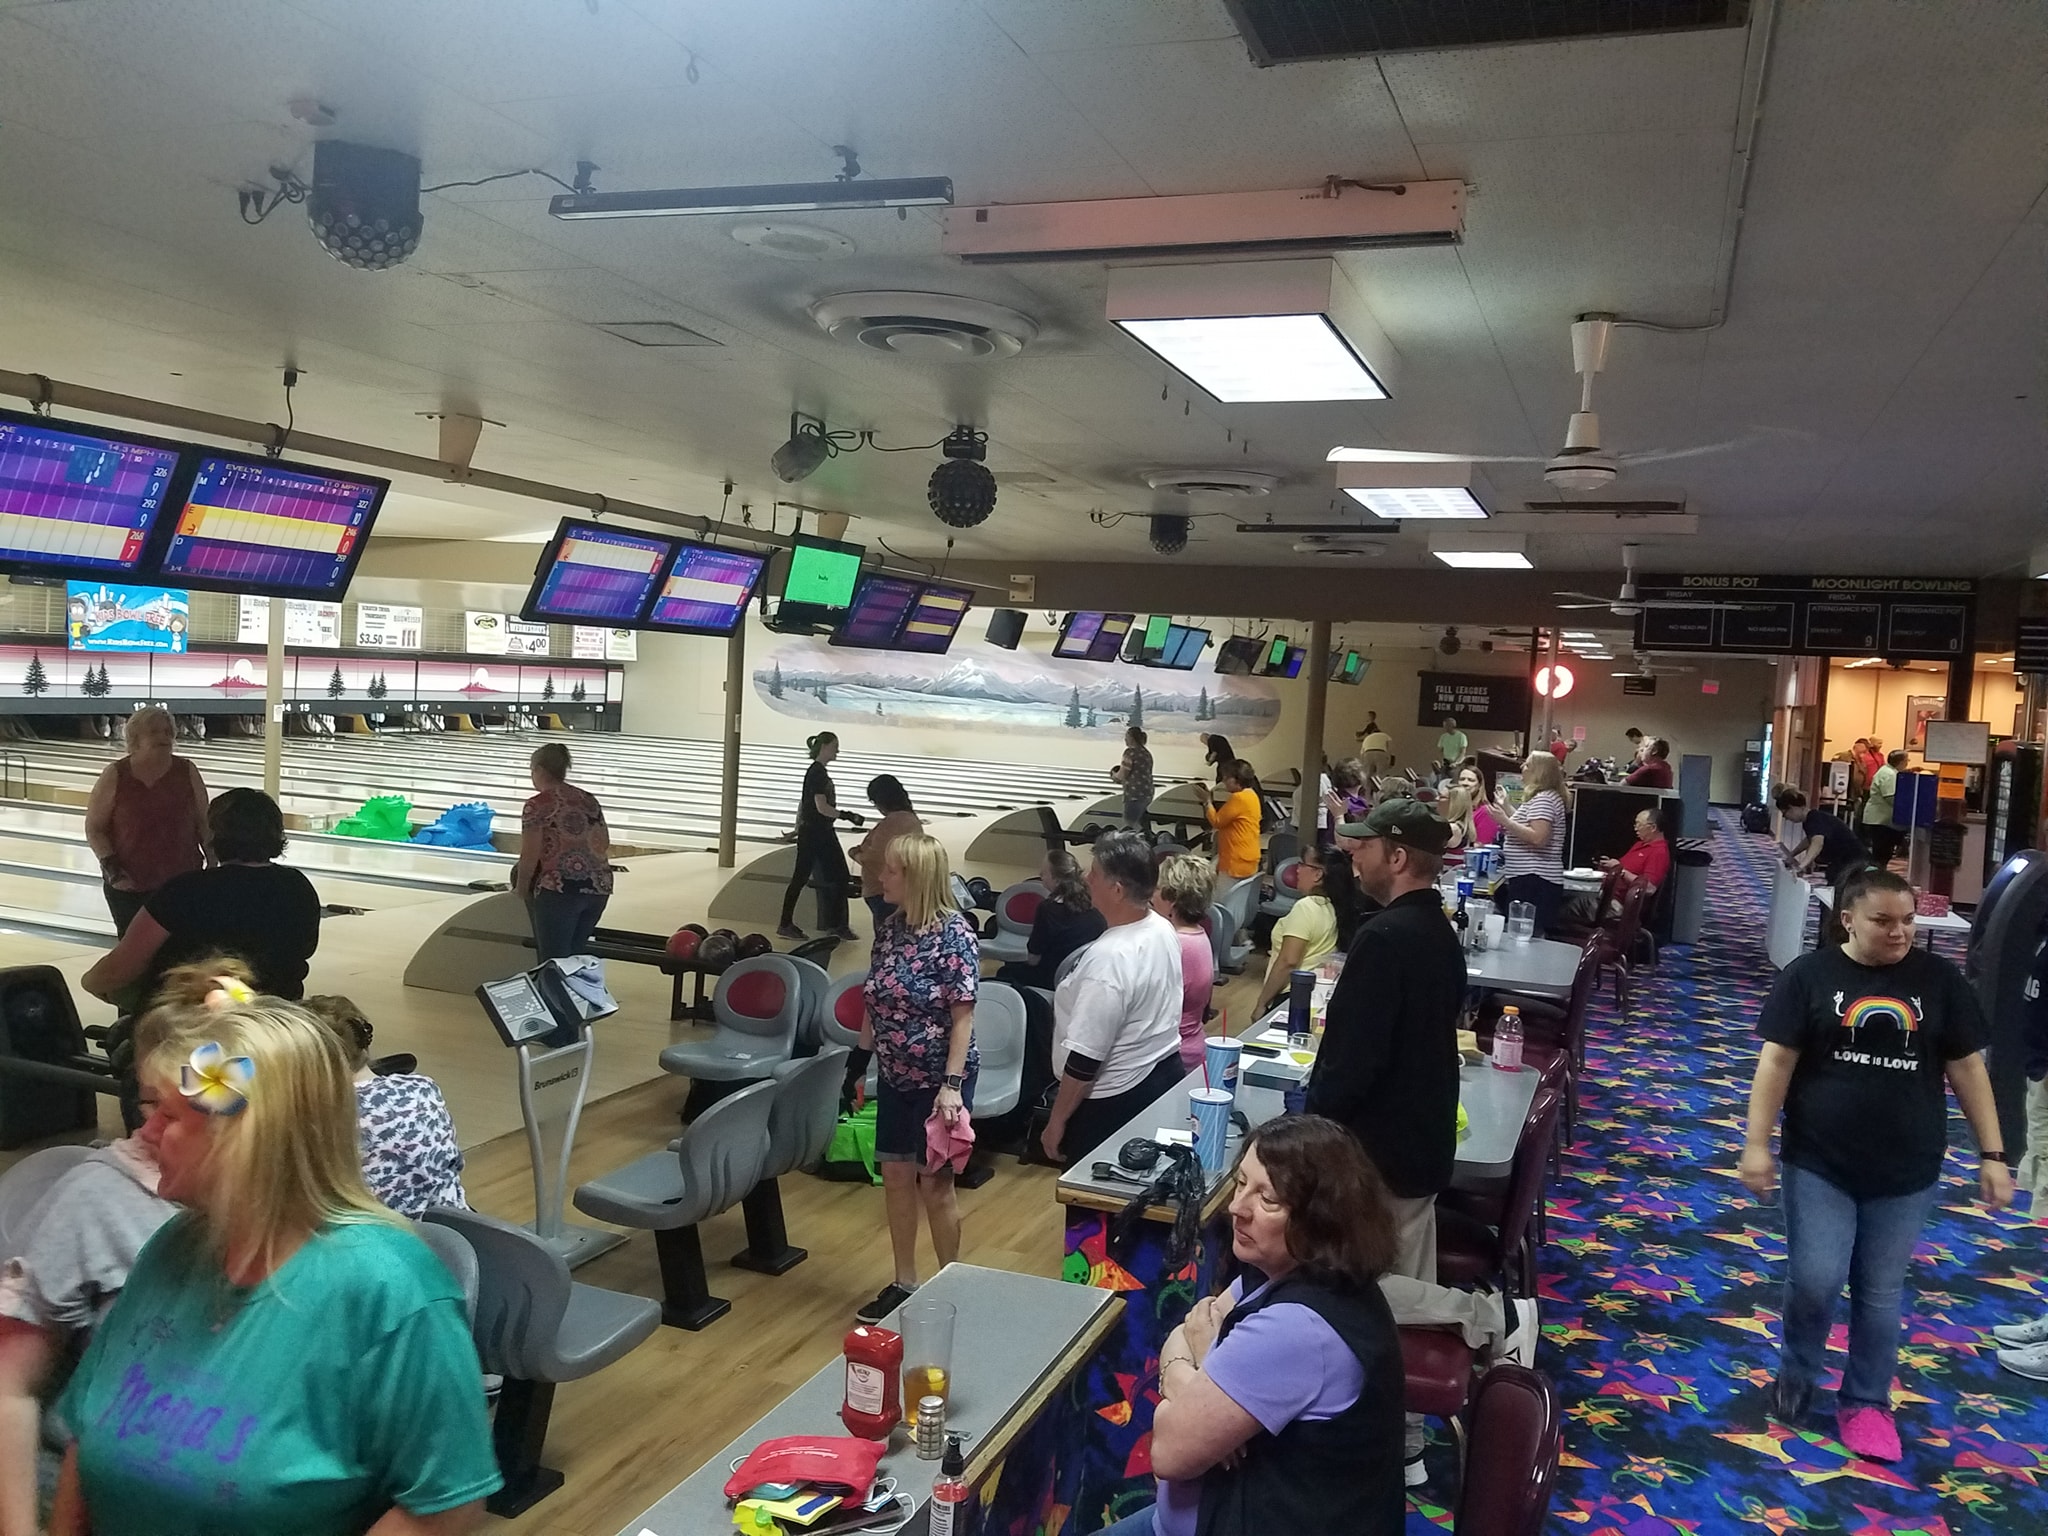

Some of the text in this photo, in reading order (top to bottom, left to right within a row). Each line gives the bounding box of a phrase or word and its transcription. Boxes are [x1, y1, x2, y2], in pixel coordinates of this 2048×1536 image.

[131, 447, 154, 456] MPH
[154, 466, 168, 478] 326
[207, 463, 215, 473] 4
[226, 464, 263, 475] EVELYN
[151, 482, 160, 496] 9
[142, 499, 156, 509] 292
[139, 513, 148, 527] 9
[130, 531, 144, 541] 268
[126, 545, 136, 559] 7
[331, 566, 339, 579] 0
[1683, 577, 1760, 587] BONUS POT
[1812, 578, 1972, 591] MOONLIGHT BOWLING
[95, 608, 166, 625] KIDS BOWL FREE
[359, 632, 383, 645] $3.50
[1435, 685, 1488, 695] FALL LEAGUES
[1438, 694, 1490, 704] NOW FORMING
[133, 702, 147, 711] 12
[299, 703, 311, 712] 15
[403, 704, 429, 712] 16 17
[1433, 702, 1489, 713] SIGN UP TODAY
[1834, 1050, 1871, 1065] LOVE
[1883, 1057, 1919, 1071] LOVE
[534, 1070, 572, 1091] Brunswick
